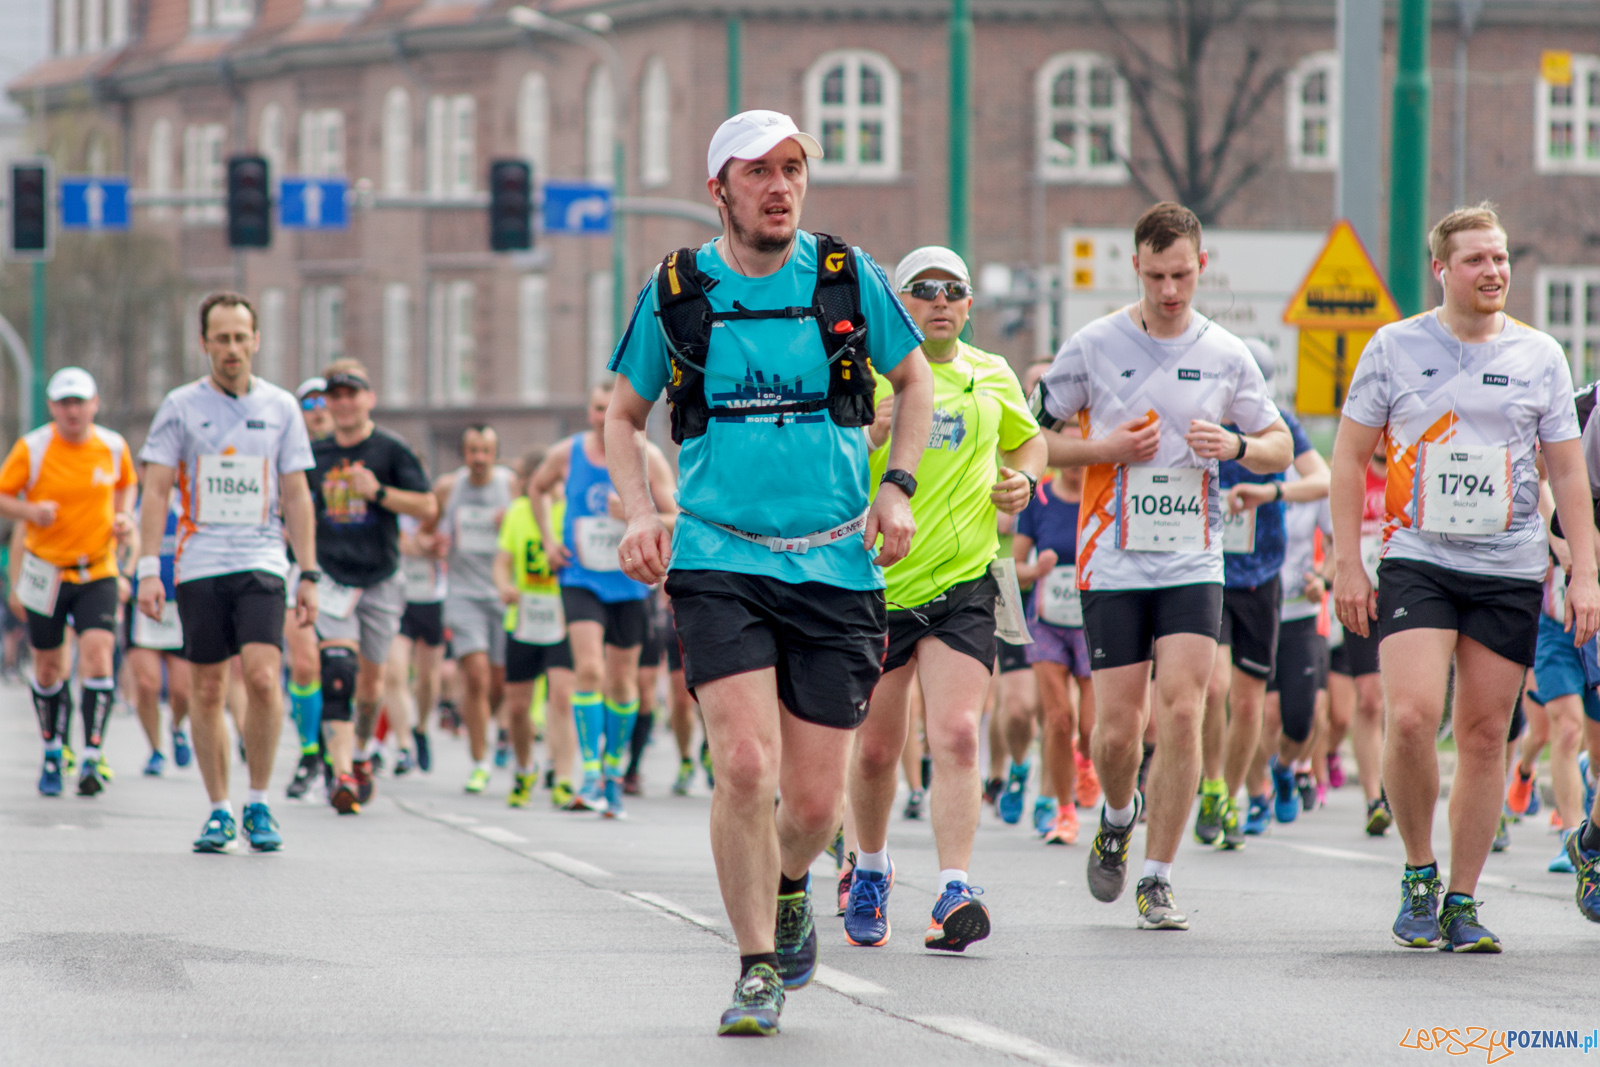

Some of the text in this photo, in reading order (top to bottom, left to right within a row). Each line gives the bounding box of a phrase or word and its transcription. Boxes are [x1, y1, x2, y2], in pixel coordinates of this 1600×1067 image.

[1421, 368, 1439, 377] 4F
[207, 477, 259, 494] 11864
[1438, 473, 1495, 497] 1794
[1131, 494, 1201, 515] 10844
